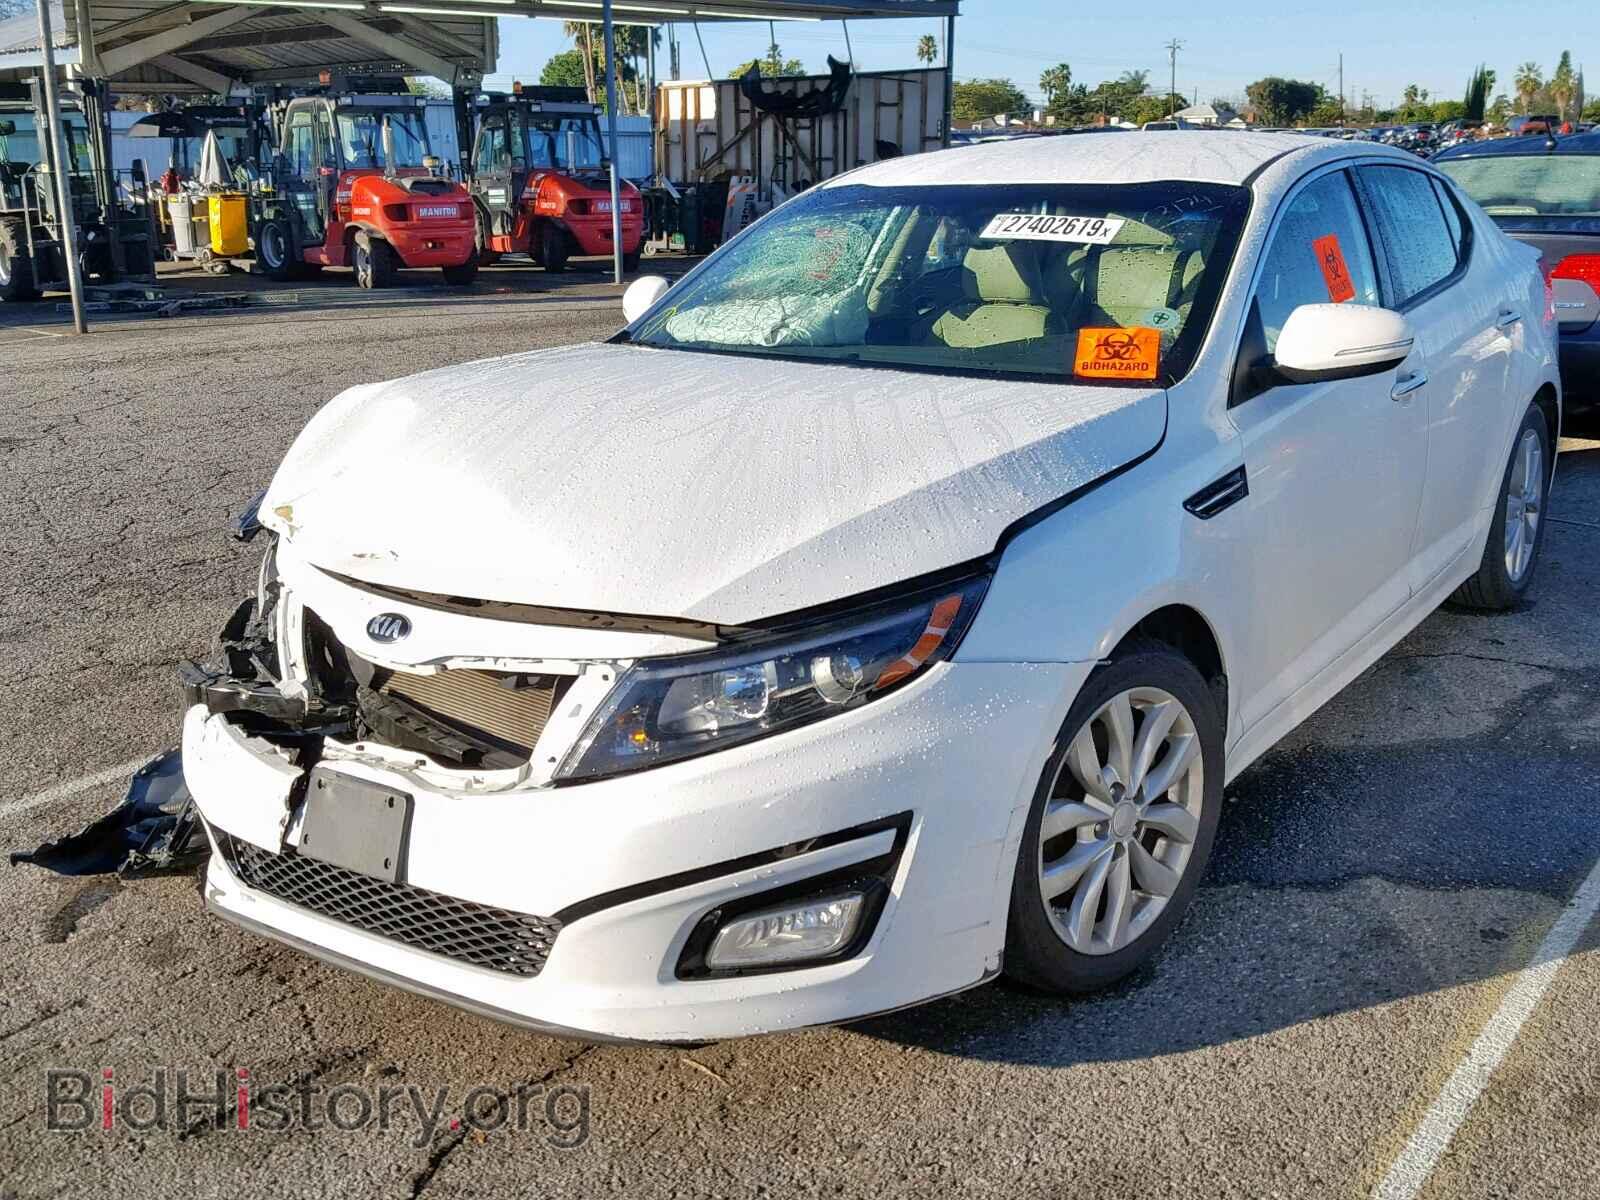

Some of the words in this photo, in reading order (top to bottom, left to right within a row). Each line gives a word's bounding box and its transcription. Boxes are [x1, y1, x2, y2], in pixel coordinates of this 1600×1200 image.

[419, 207, 457, 217] MANITOU
[1081, 361, 1150, 372] BIOHAZARD
[369, 616, 402, 639] KIA
